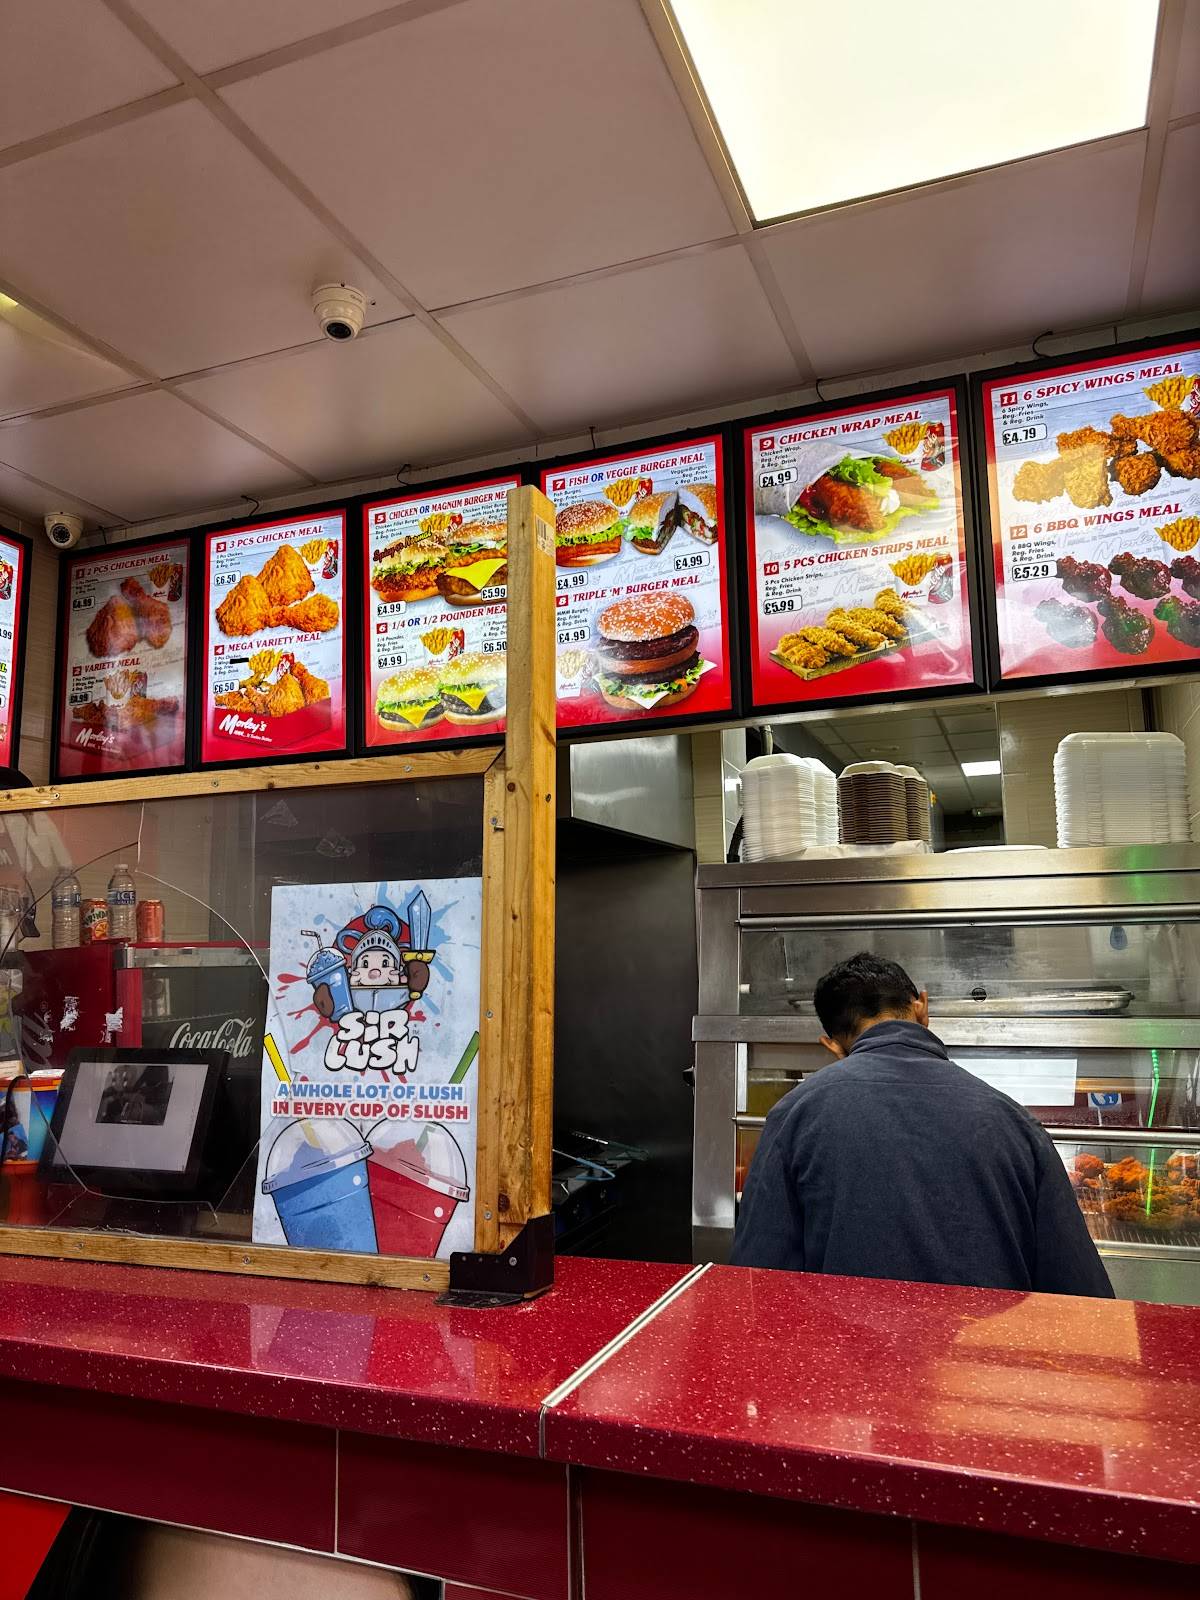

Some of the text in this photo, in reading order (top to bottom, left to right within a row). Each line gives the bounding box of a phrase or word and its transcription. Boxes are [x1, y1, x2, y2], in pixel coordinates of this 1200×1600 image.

[1001, 363, 1183, 406] 11 6 SPICY WINGS MEAL
[1007, 405, 1025, 414] Spicy
[1027, 414, 1044, 422] Drink
[761, 410, 922, 450] 9 CHICKEN WRAP MEAL
[1003, 428, 1036, 445] £4.79
[760, 449, 783, 457] Chicken
[553, 453, 704, 490] 7 FISH OR VEGGIE BURGER MEAL
[762, 471, 791, 487] £4.99
[375, 513, 386, 523] 5
[389, 507, 418, 520] CHICKEN
[419, 505, 430, 514] OR
[431, 500, 463, 512] MAGNUM
[464, 494, 493, 506] BURGER
[1011, 503, 1183, 539] 12 6 BBQ WINGS MEAL
[217, 525, 324, 552] 3 3 PCS CHICKEN MEAL
[675, 555, 702, 570] £4.99
[764, 536, 949, 574] 10 5 PCS CHICKEN STRIPS MEAL
[93, 565, 108, 574] PCS
[110, 559, 146, 571] CHICKEN
[148, 554, 170, 564] MEAL
[216, 574, 236, 585] £6.50
[781, 575, 804, 583] Chicken
[1014, 565, 1049, 579] £5.29
[558, 575, 584, 589] £4.99
[482, 588, 506, 599] £5.99
[557, 596, 567, 606] 8
[572, 589, 606, 602] TRIPLE
[626, 580, 669, 594] BURGER
[671, 575, 701, 587] MEAL
[377, 603, 401, 615] £4.99
[764, 599, 794, 614] £5.99
[377, 605, 507, 633] 6 1/4 OR 1/2 POUNDER MEA
[214, 633, 321, 655] 4 MEGA VARIETY MEAL
[559, 630, 586, 643] £4.99
[484, 641, 507, 652] £6.50
[84, 662, 115, 674] VARIETY
[118, 657, 141, 667] MEAL
[378, 656, 402, 668] £4.99
[214, 682, 234, 693] £6.50
[116, 890, 135, 900] ICE
[278, 1084, 463, 1101] A WHOLE LOT OF LUSH
[273, 1101, 468, 1120] IN EVERY CUP OF SLUSH
